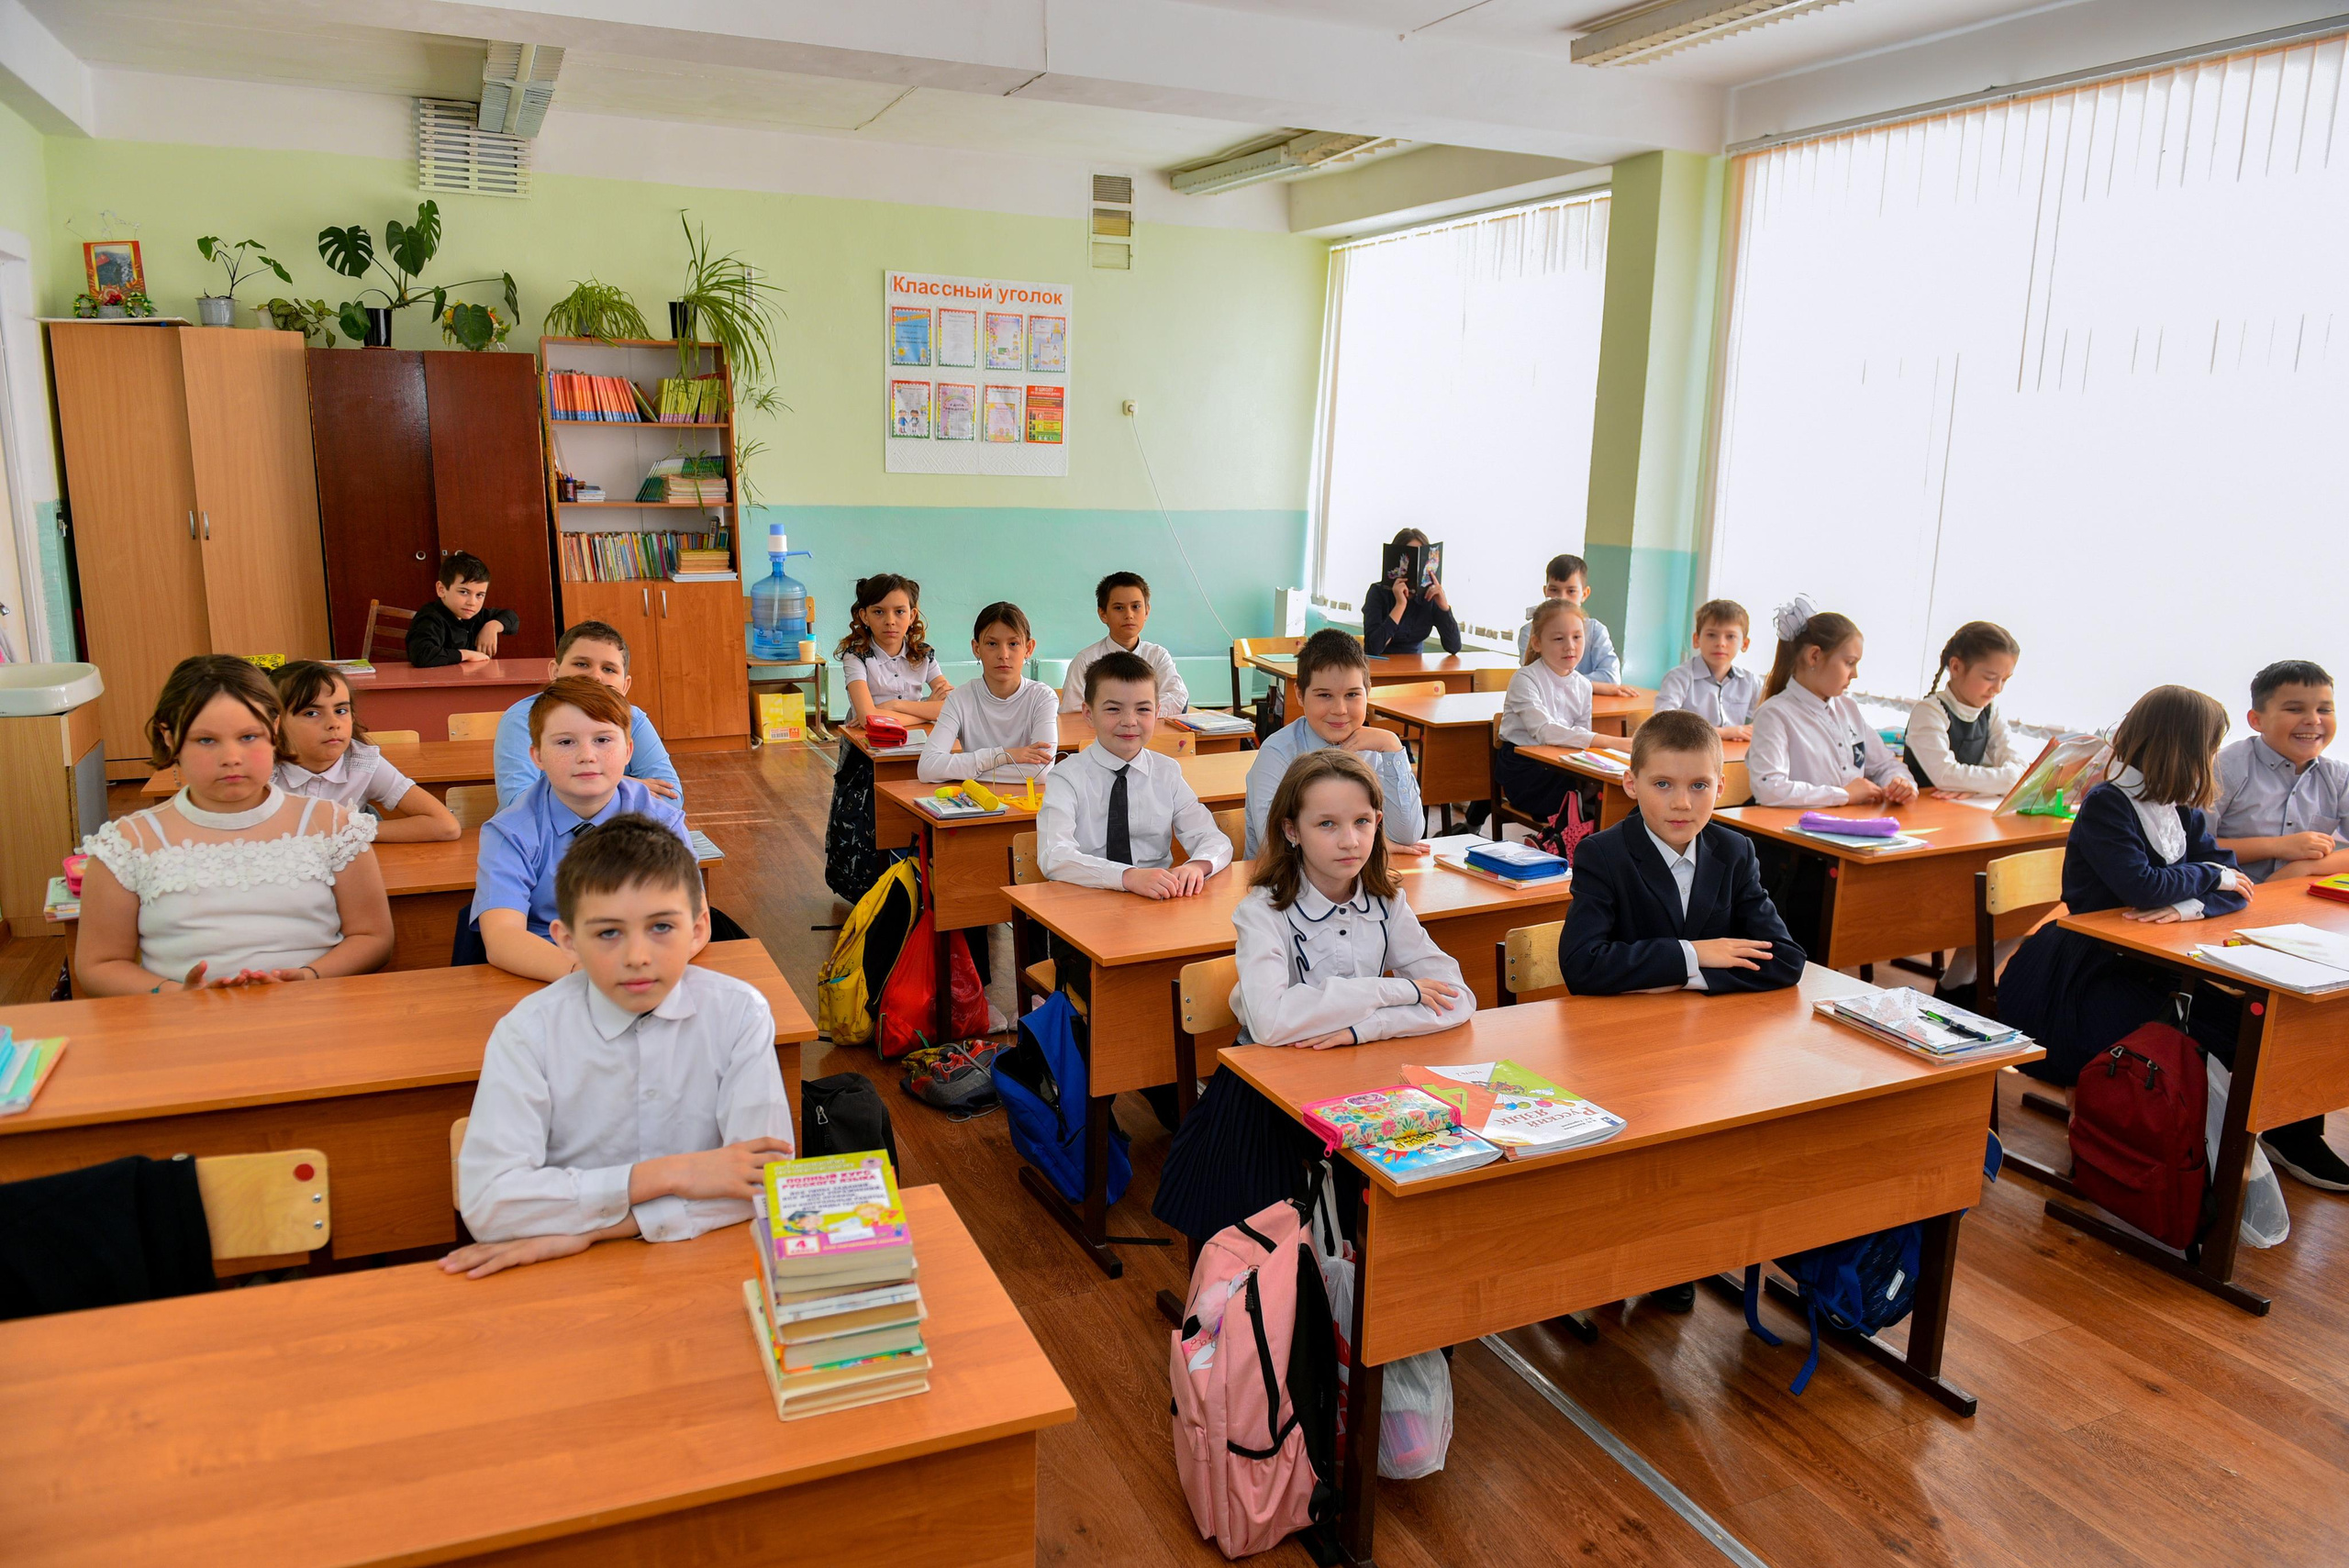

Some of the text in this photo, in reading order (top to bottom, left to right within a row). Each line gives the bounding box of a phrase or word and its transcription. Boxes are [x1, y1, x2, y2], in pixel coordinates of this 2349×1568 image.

[893, 275, 1063, 306] Классный уголок
[1527, 1106, 1599, 1129] Русский
[782, 1174, 876, 1190] РУССКОГО ЯЗЫКА
[786, 1170, 872, 1184] ПОЛНЫЙ КУРС
